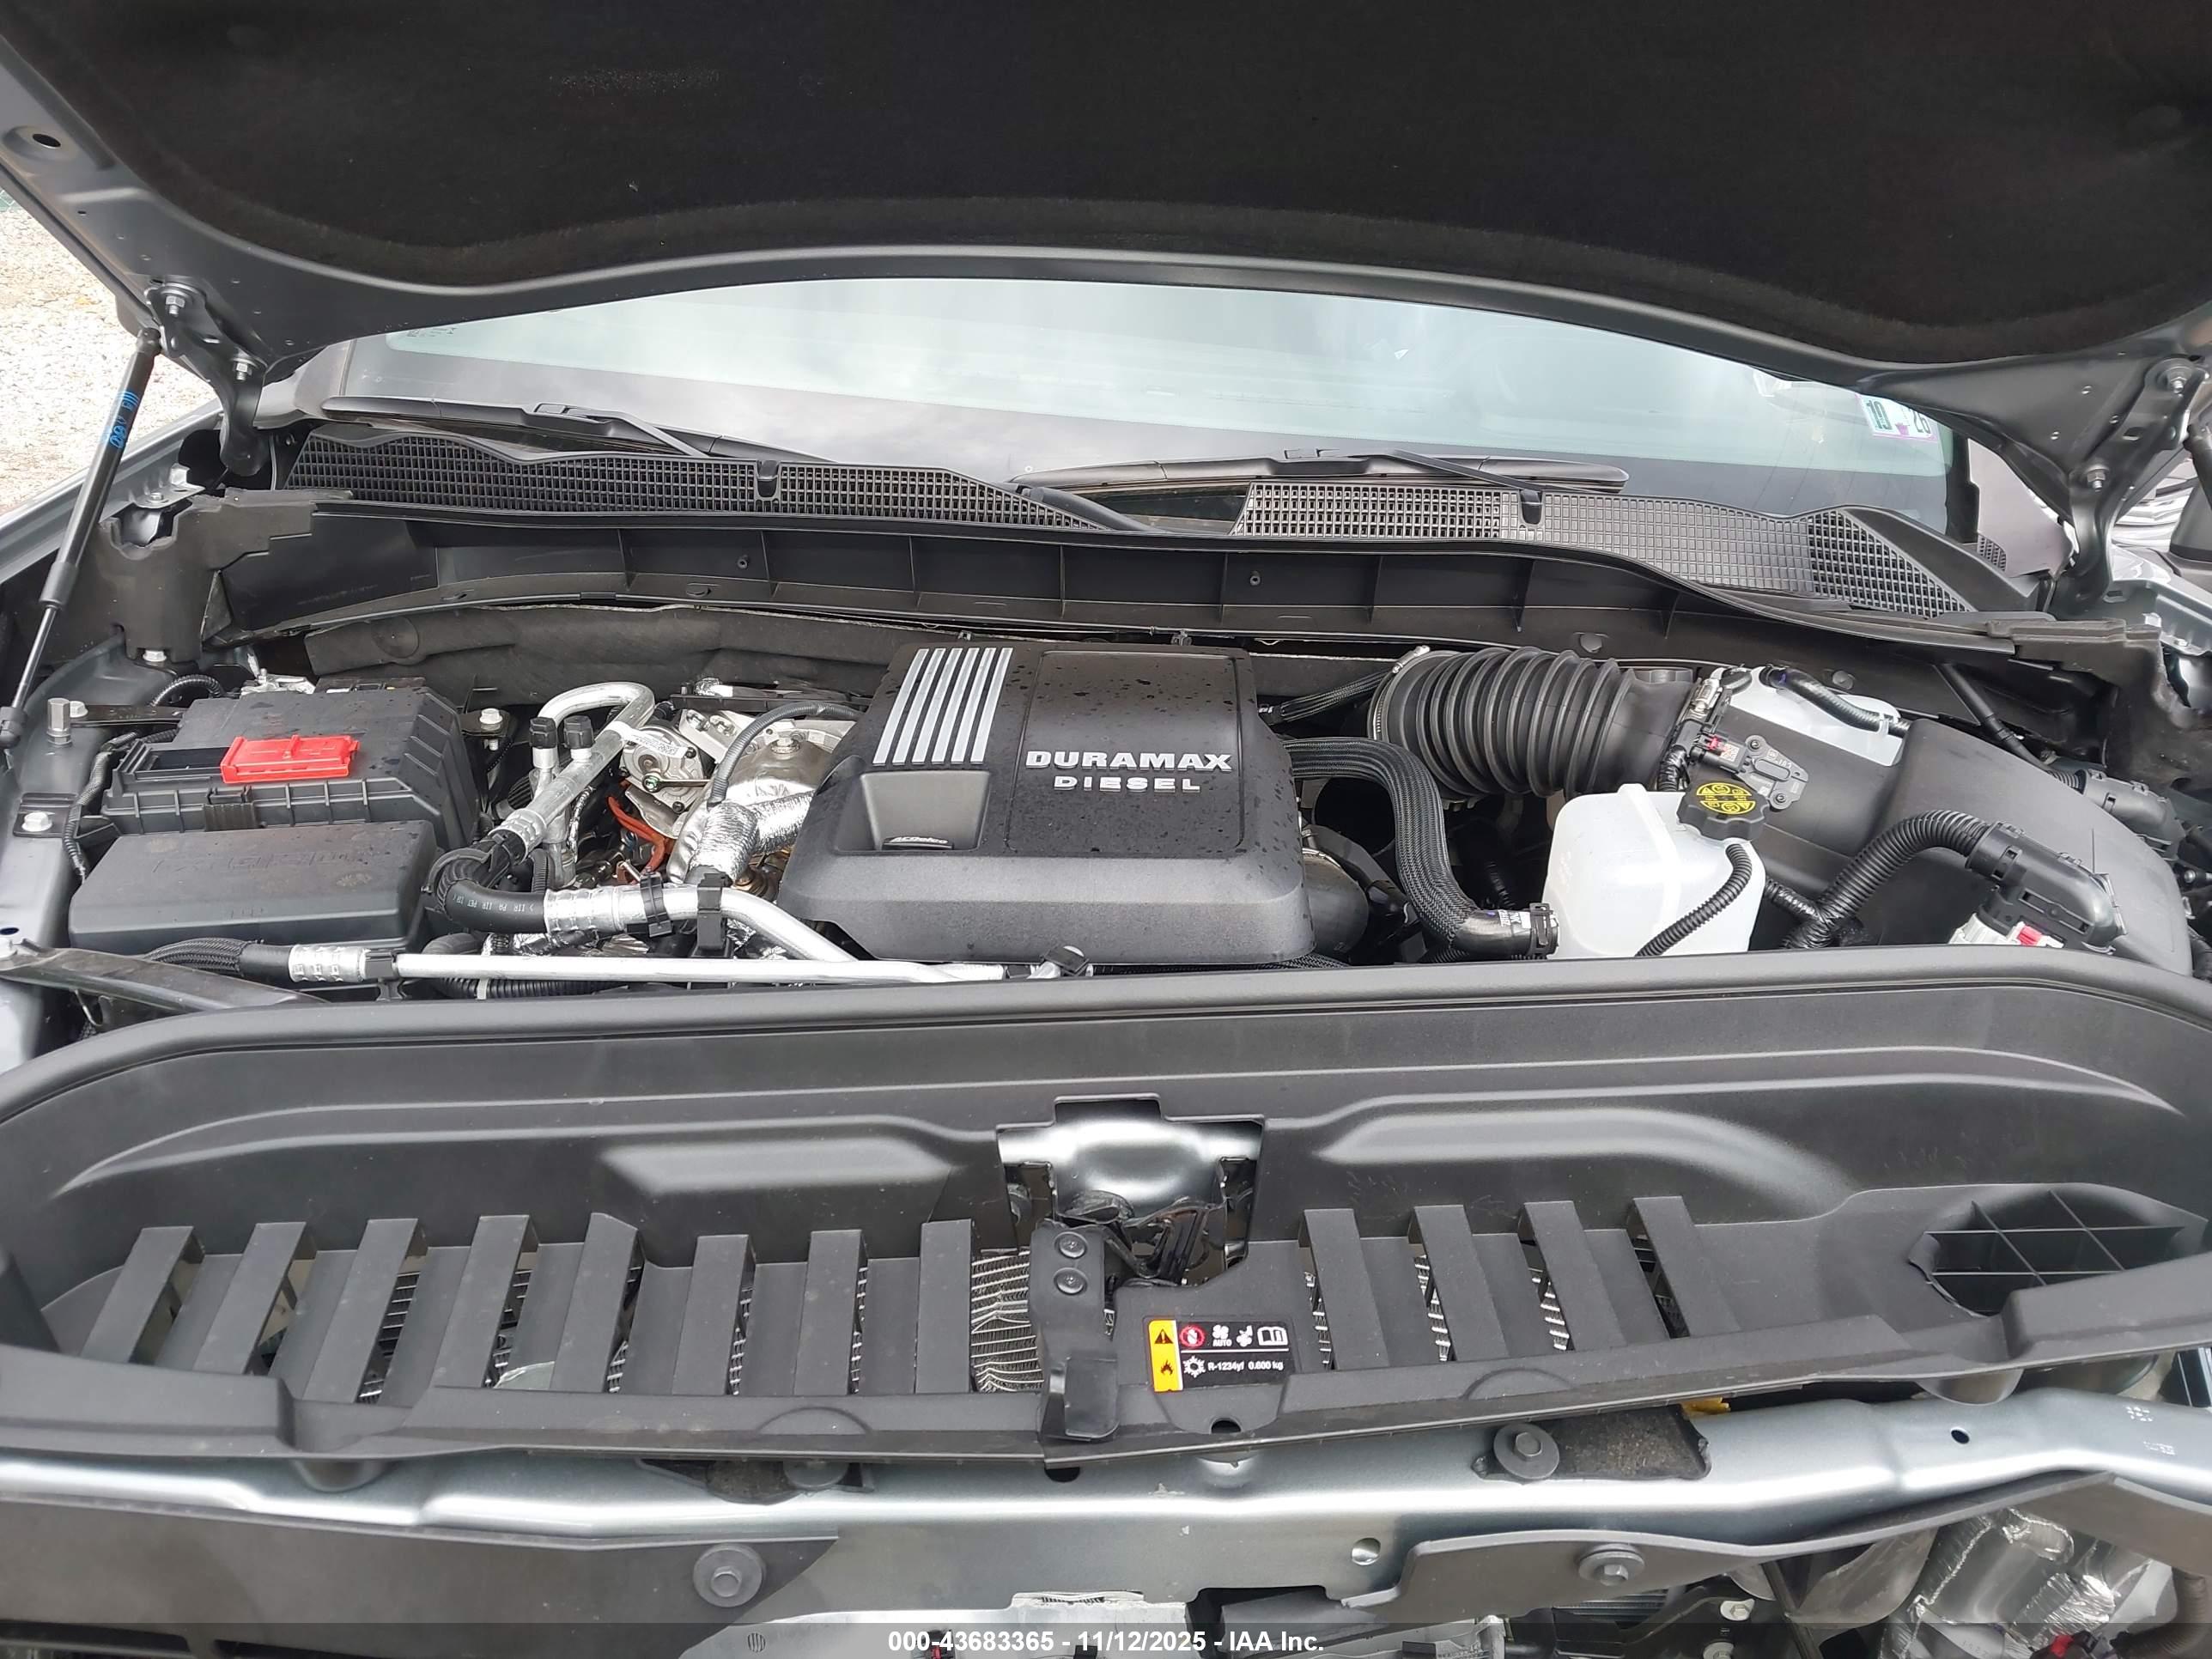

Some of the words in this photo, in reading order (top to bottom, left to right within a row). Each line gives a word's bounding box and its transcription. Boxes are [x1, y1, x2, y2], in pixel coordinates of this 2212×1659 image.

[1025, 750, 1232, 771] DURAMAX
[1054, 775, 1200, 793] DIESEL
[1273, 1360, 1284, 1371] kg
